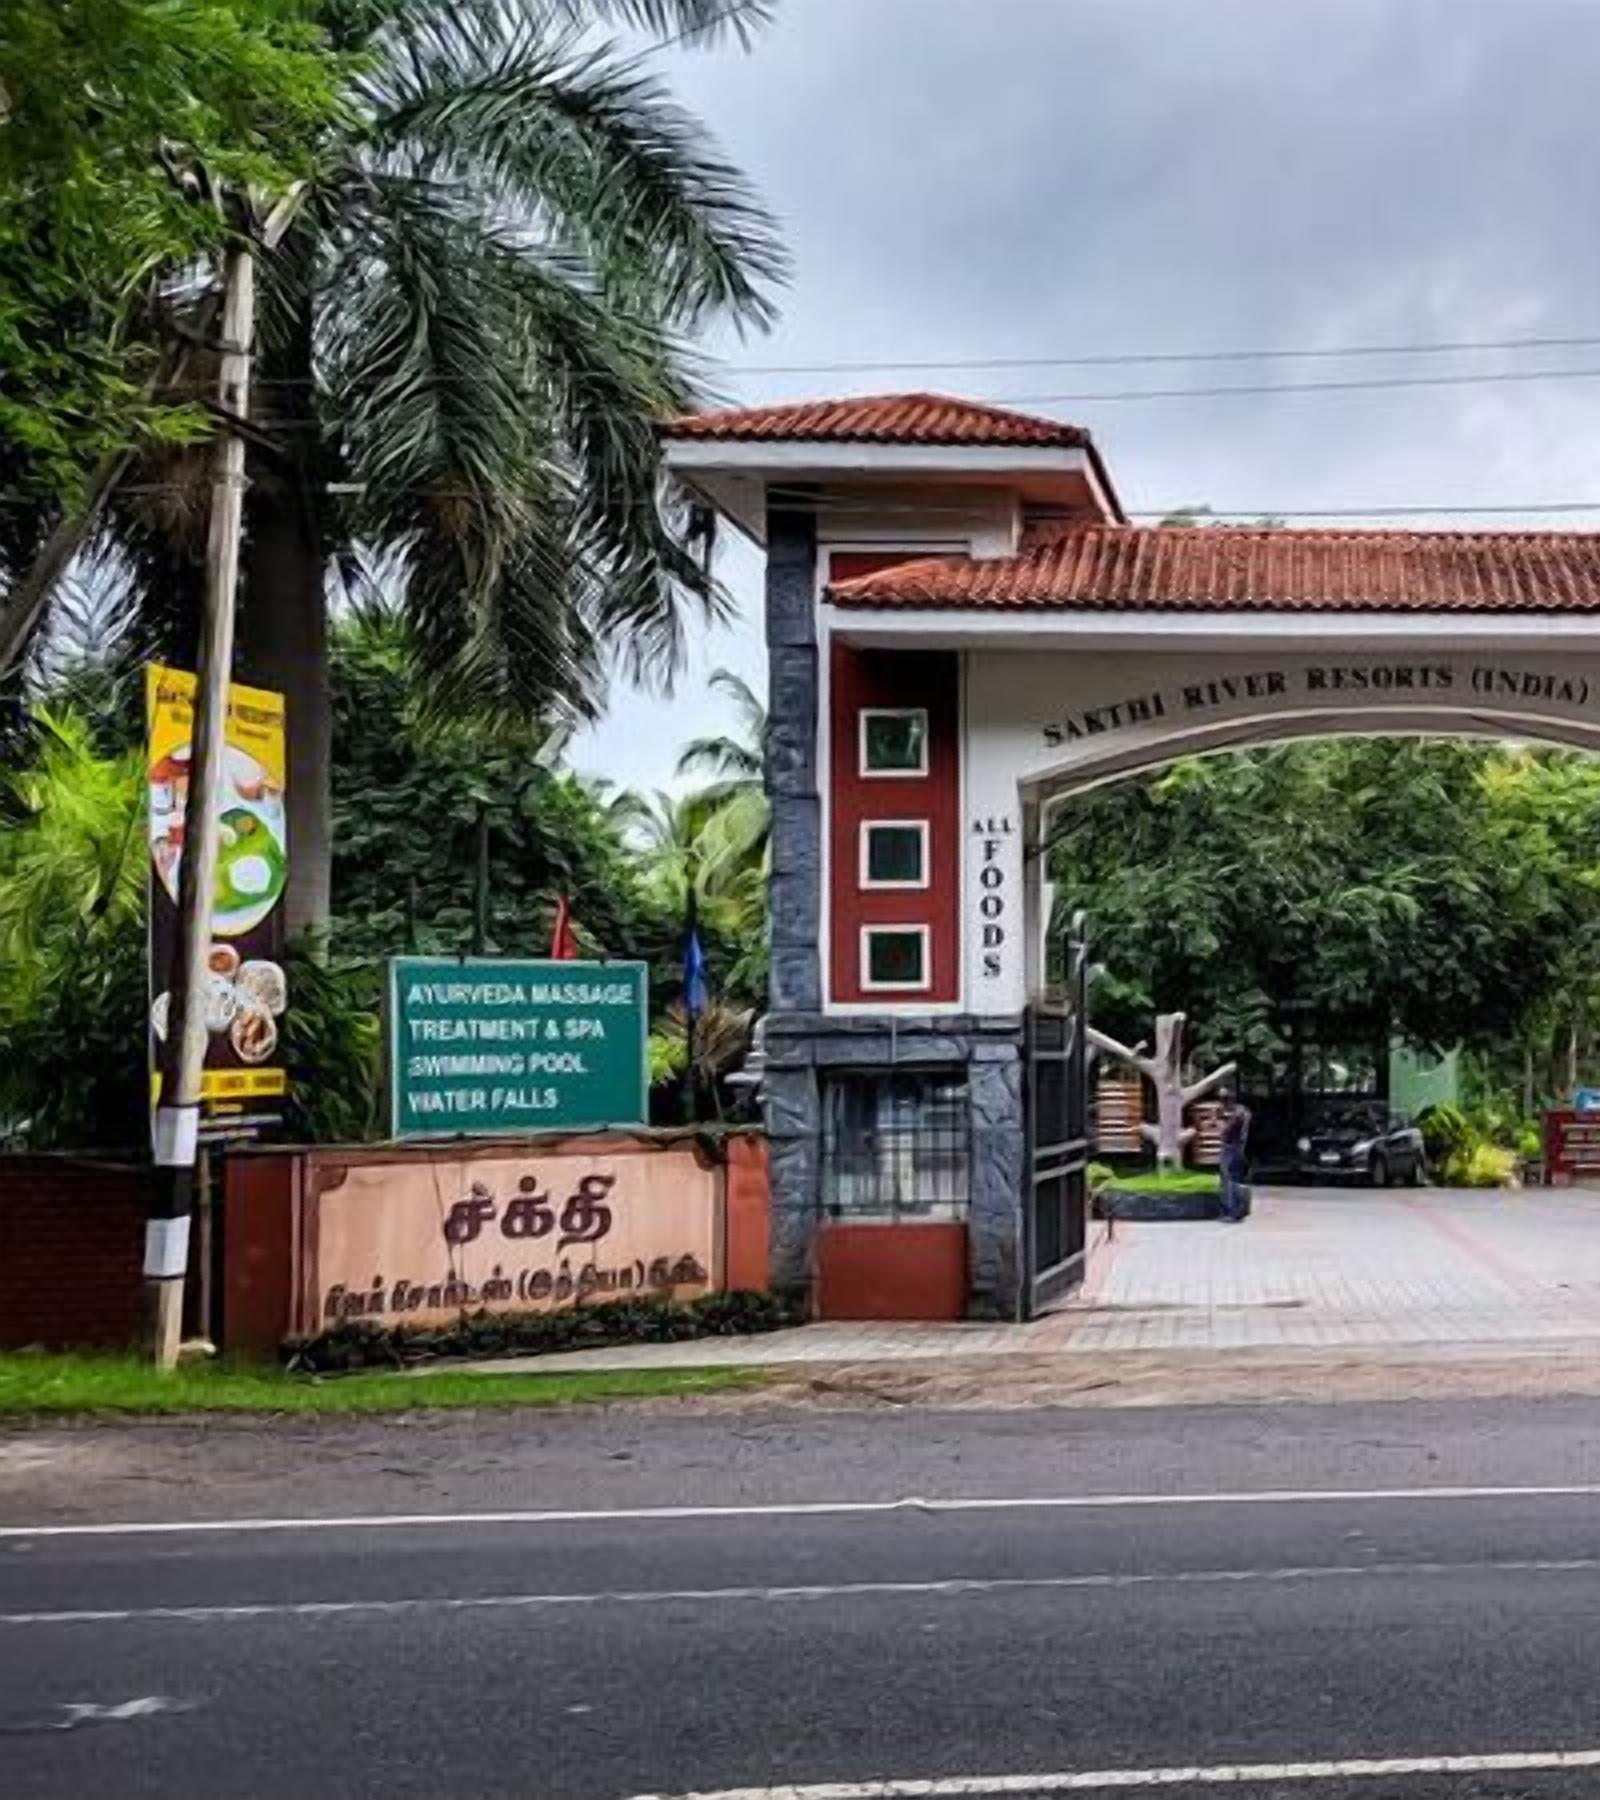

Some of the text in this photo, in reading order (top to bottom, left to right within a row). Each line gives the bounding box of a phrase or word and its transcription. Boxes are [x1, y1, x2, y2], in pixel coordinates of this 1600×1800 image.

[1044, 692, 1164, 747] SAKTHI
[1183, 671, 1286, 707] RIVER
[1306, 666, 1451, 690] RESORTS
[1472, 668, 1588, 704] (INDIA)
[973, 817, 1013, 834] ALL
[981, 840, 1004, 977] FOODS
[408, 983, 633, 1004] AYURVEDA MASSAGE
[409, 1018, 605, 1040] TREATMENT & SPA
[408, 1052, 589, 1077] SWIMMING POOL
[408, 1087, 558, 1112] WATER FALLS
